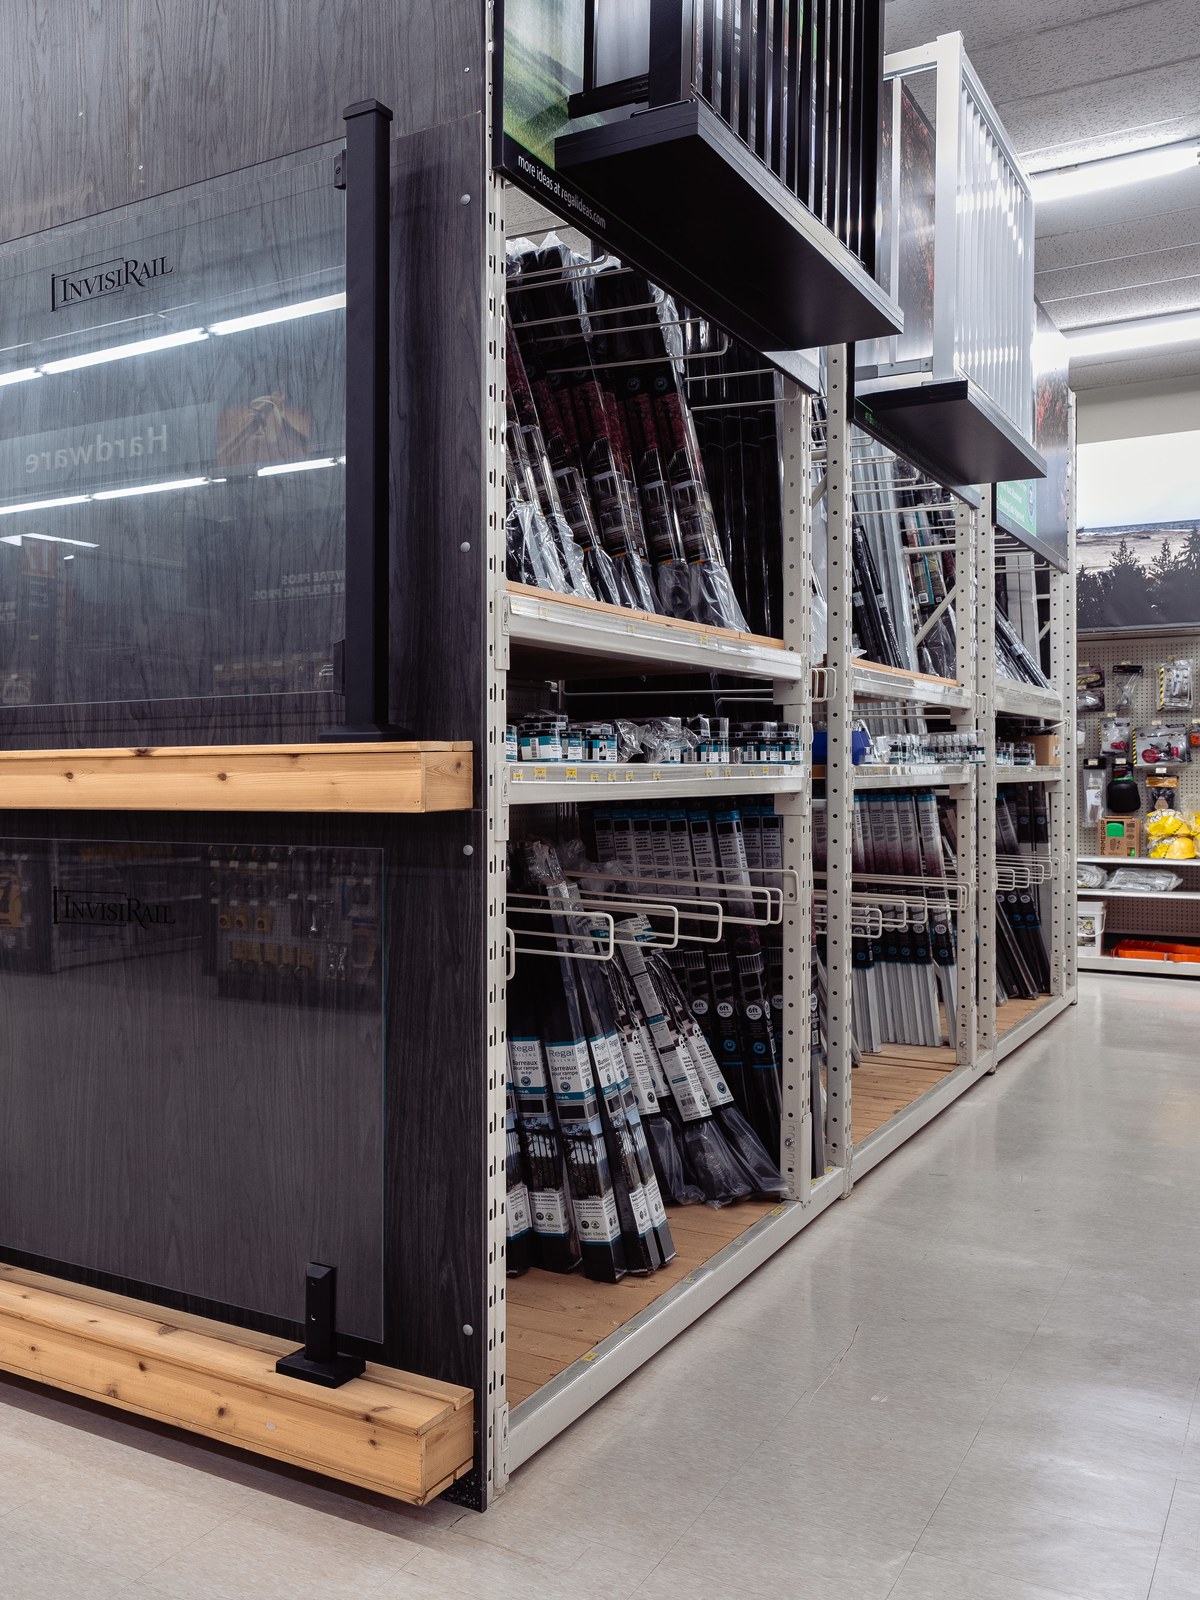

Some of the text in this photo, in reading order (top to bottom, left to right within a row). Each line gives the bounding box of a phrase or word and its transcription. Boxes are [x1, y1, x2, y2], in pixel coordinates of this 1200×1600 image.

[517, 155, 606, 230] more ideas at regalideas.com
[511, 1044, 536, 1053] Regal
[548, 1049, 574, 1058] Regal
